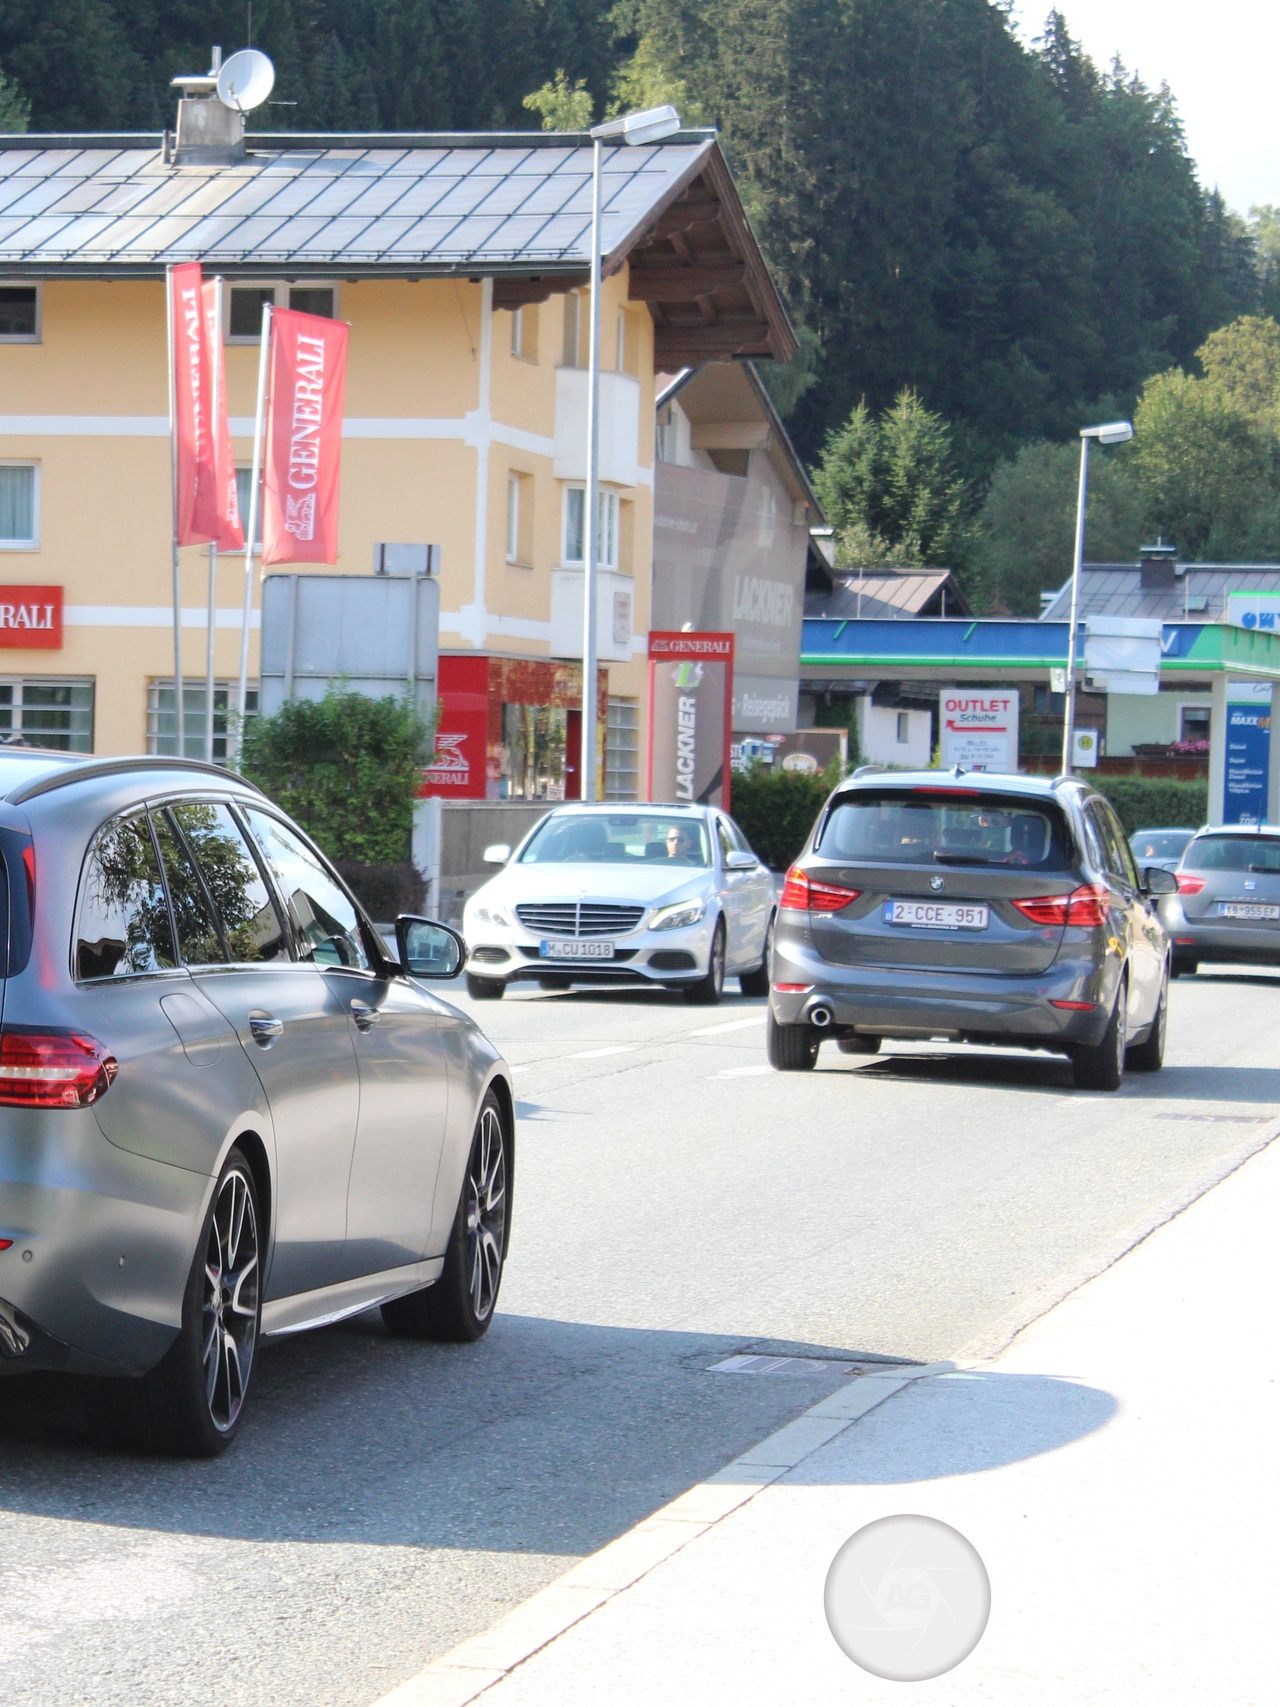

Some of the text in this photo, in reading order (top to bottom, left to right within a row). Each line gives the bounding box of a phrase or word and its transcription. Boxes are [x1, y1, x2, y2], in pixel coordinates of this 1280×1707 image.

[287, 333, 325, 491] GENERALI
[732, 575, 795, 628] LACKNER
[1241, 612, 1280, 630] OM
[669, 640, 731, 654] GENERALI
[945, 699, 1010, 713] OUTLET
[959, 713, 997, 724] Schuhe
[675, 696, 697, 800] LACKNER
[422, 771, 470, 785] NERALI
[563, 943, 579, 955] CU
[580, 944, 611, 956] 1018
